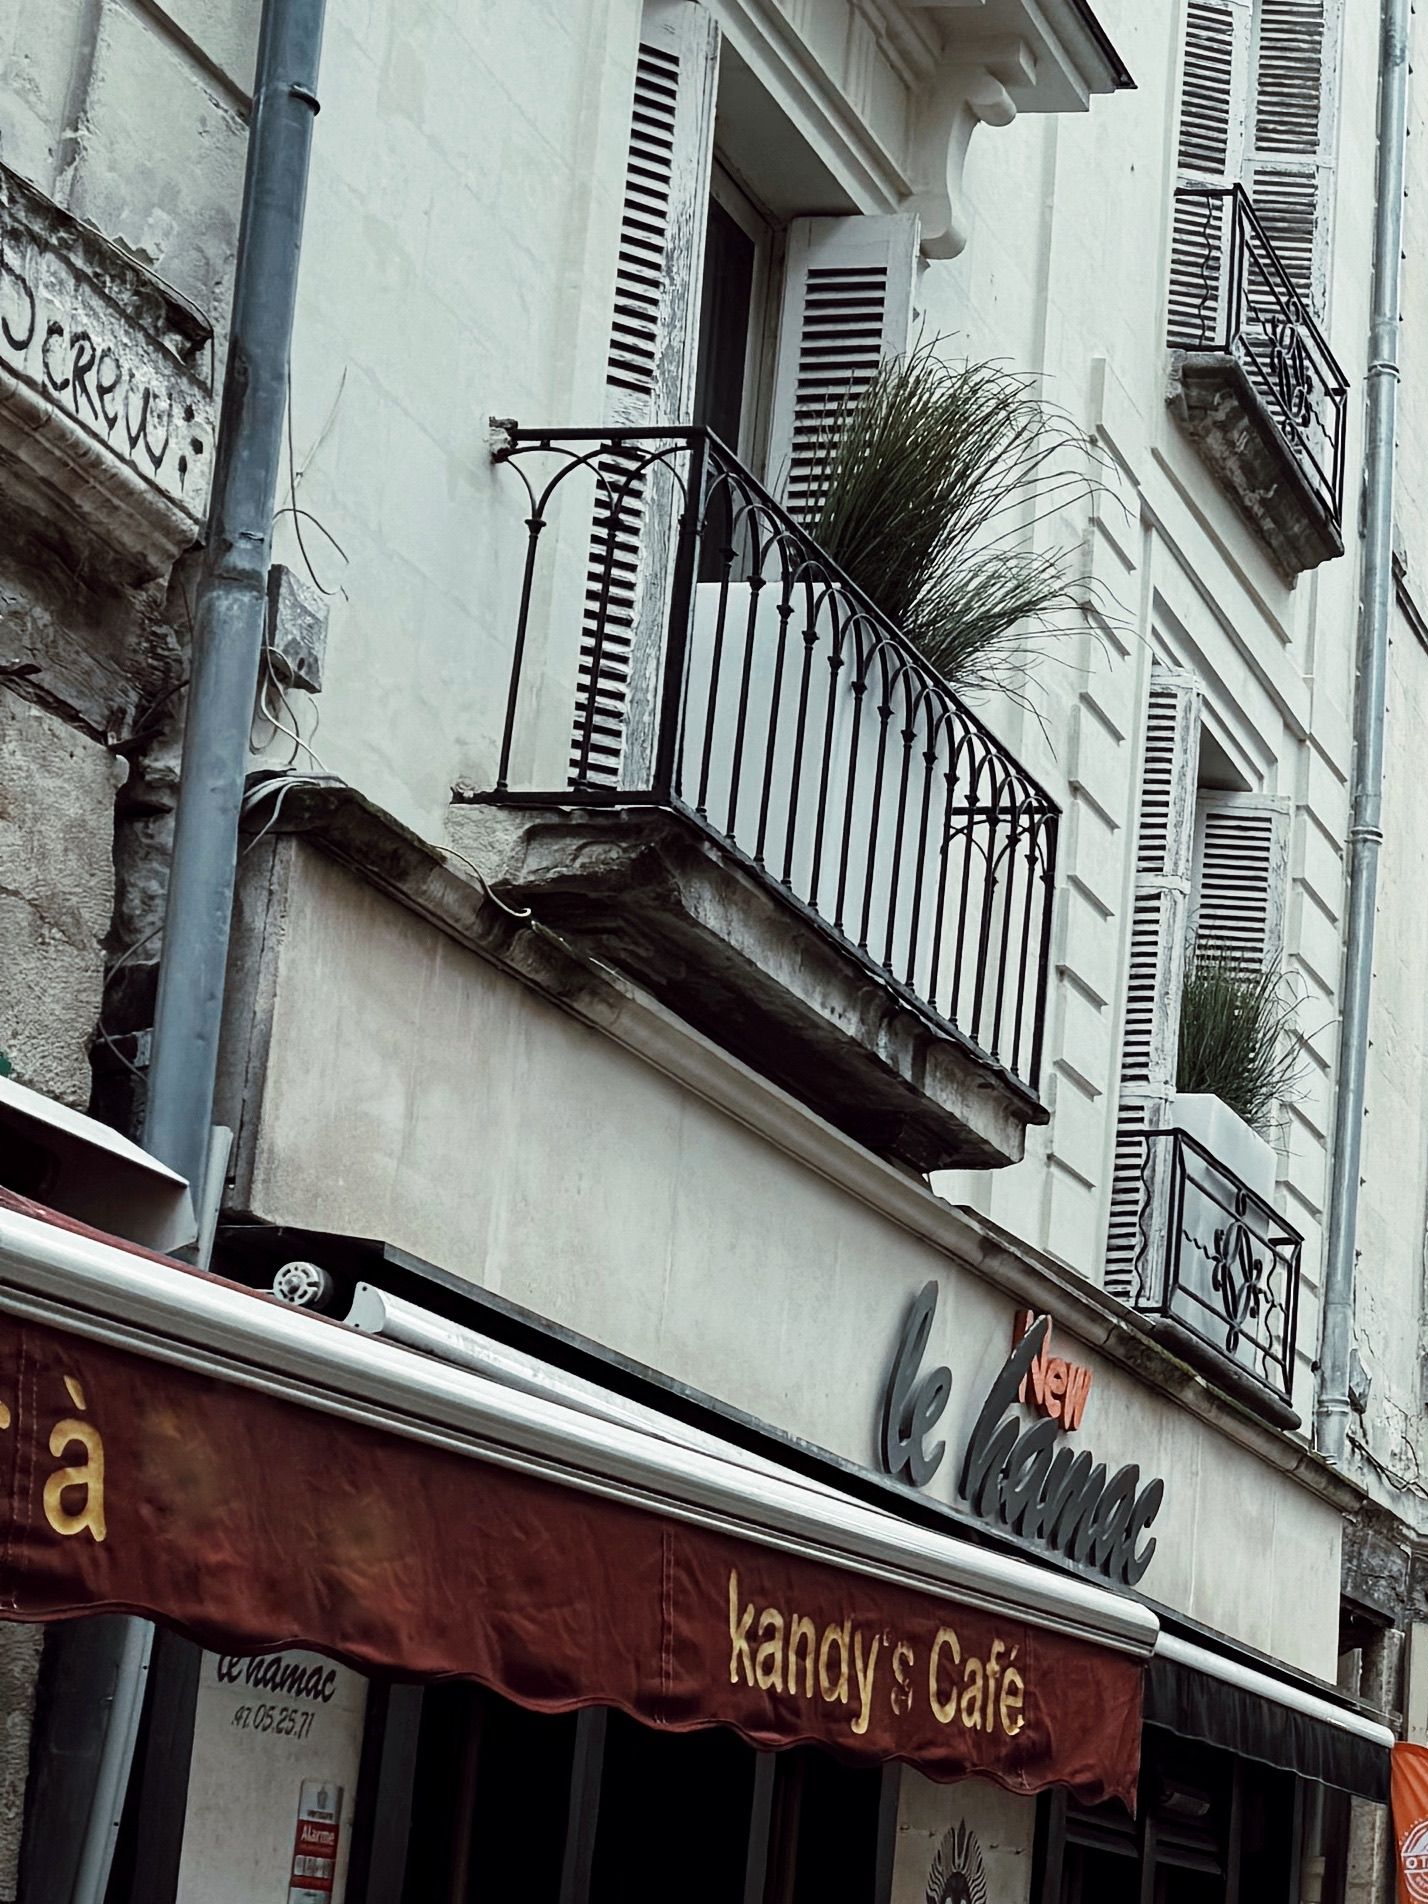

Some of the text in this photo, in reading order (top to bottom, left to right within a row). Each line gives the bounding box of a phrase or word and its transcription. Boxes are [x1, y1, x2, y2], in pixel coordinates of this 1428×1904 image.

[881, 1280, 1165, 1586] le hamac
[728, 1568, 1026, 1736] kandy's Café
[300, 1824, 336, 1846] Alarme
